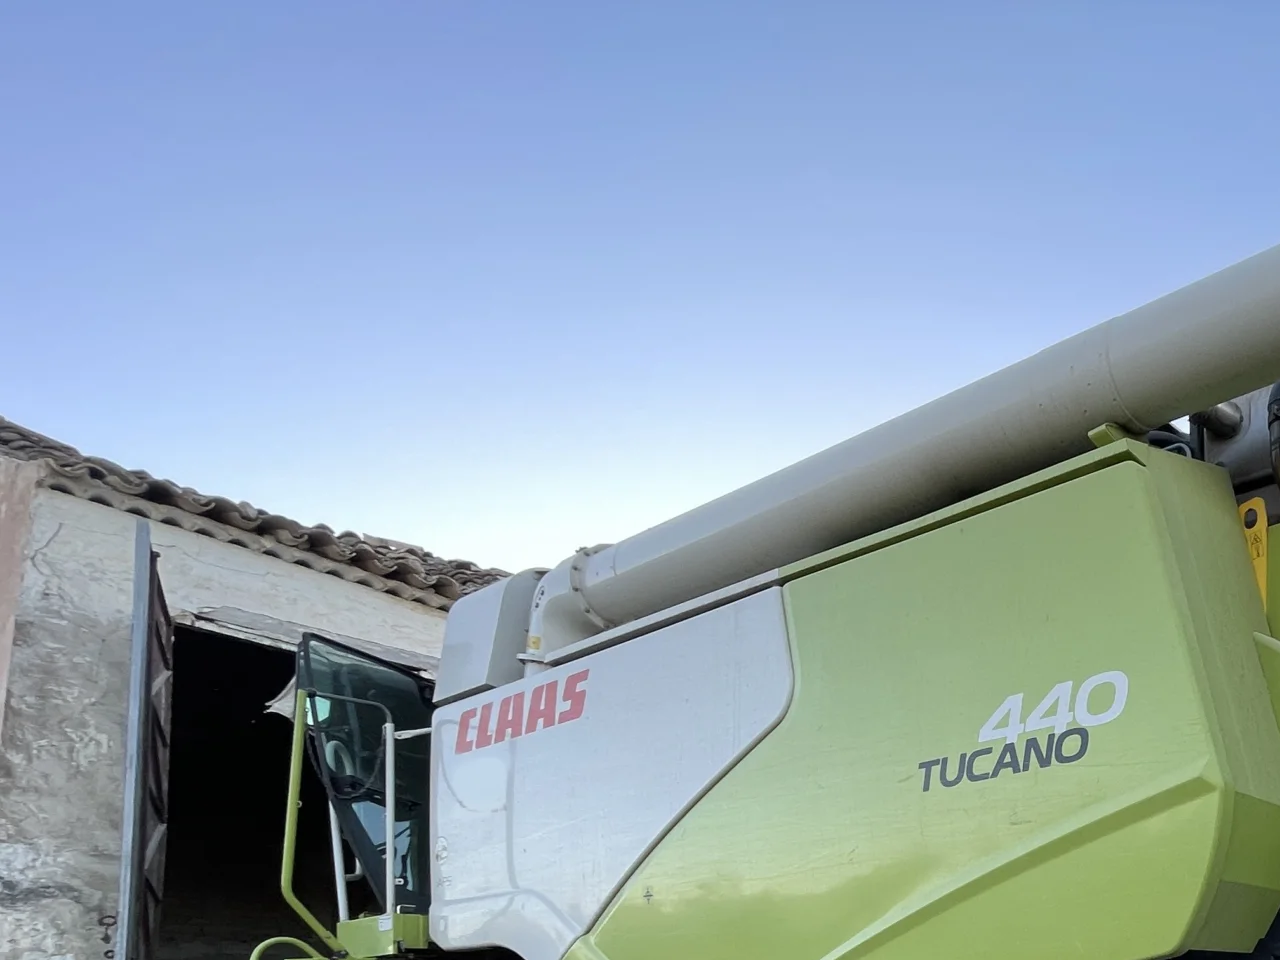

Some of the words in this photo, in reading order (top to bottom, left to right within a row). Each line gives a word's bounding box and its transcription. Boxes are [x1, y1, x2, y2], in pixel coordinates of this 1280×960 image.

[455, 669, 590, 755] CLAAS
[978, 670, 1129, 743] 440
[918, 727, 1089, 792] TUCANO
